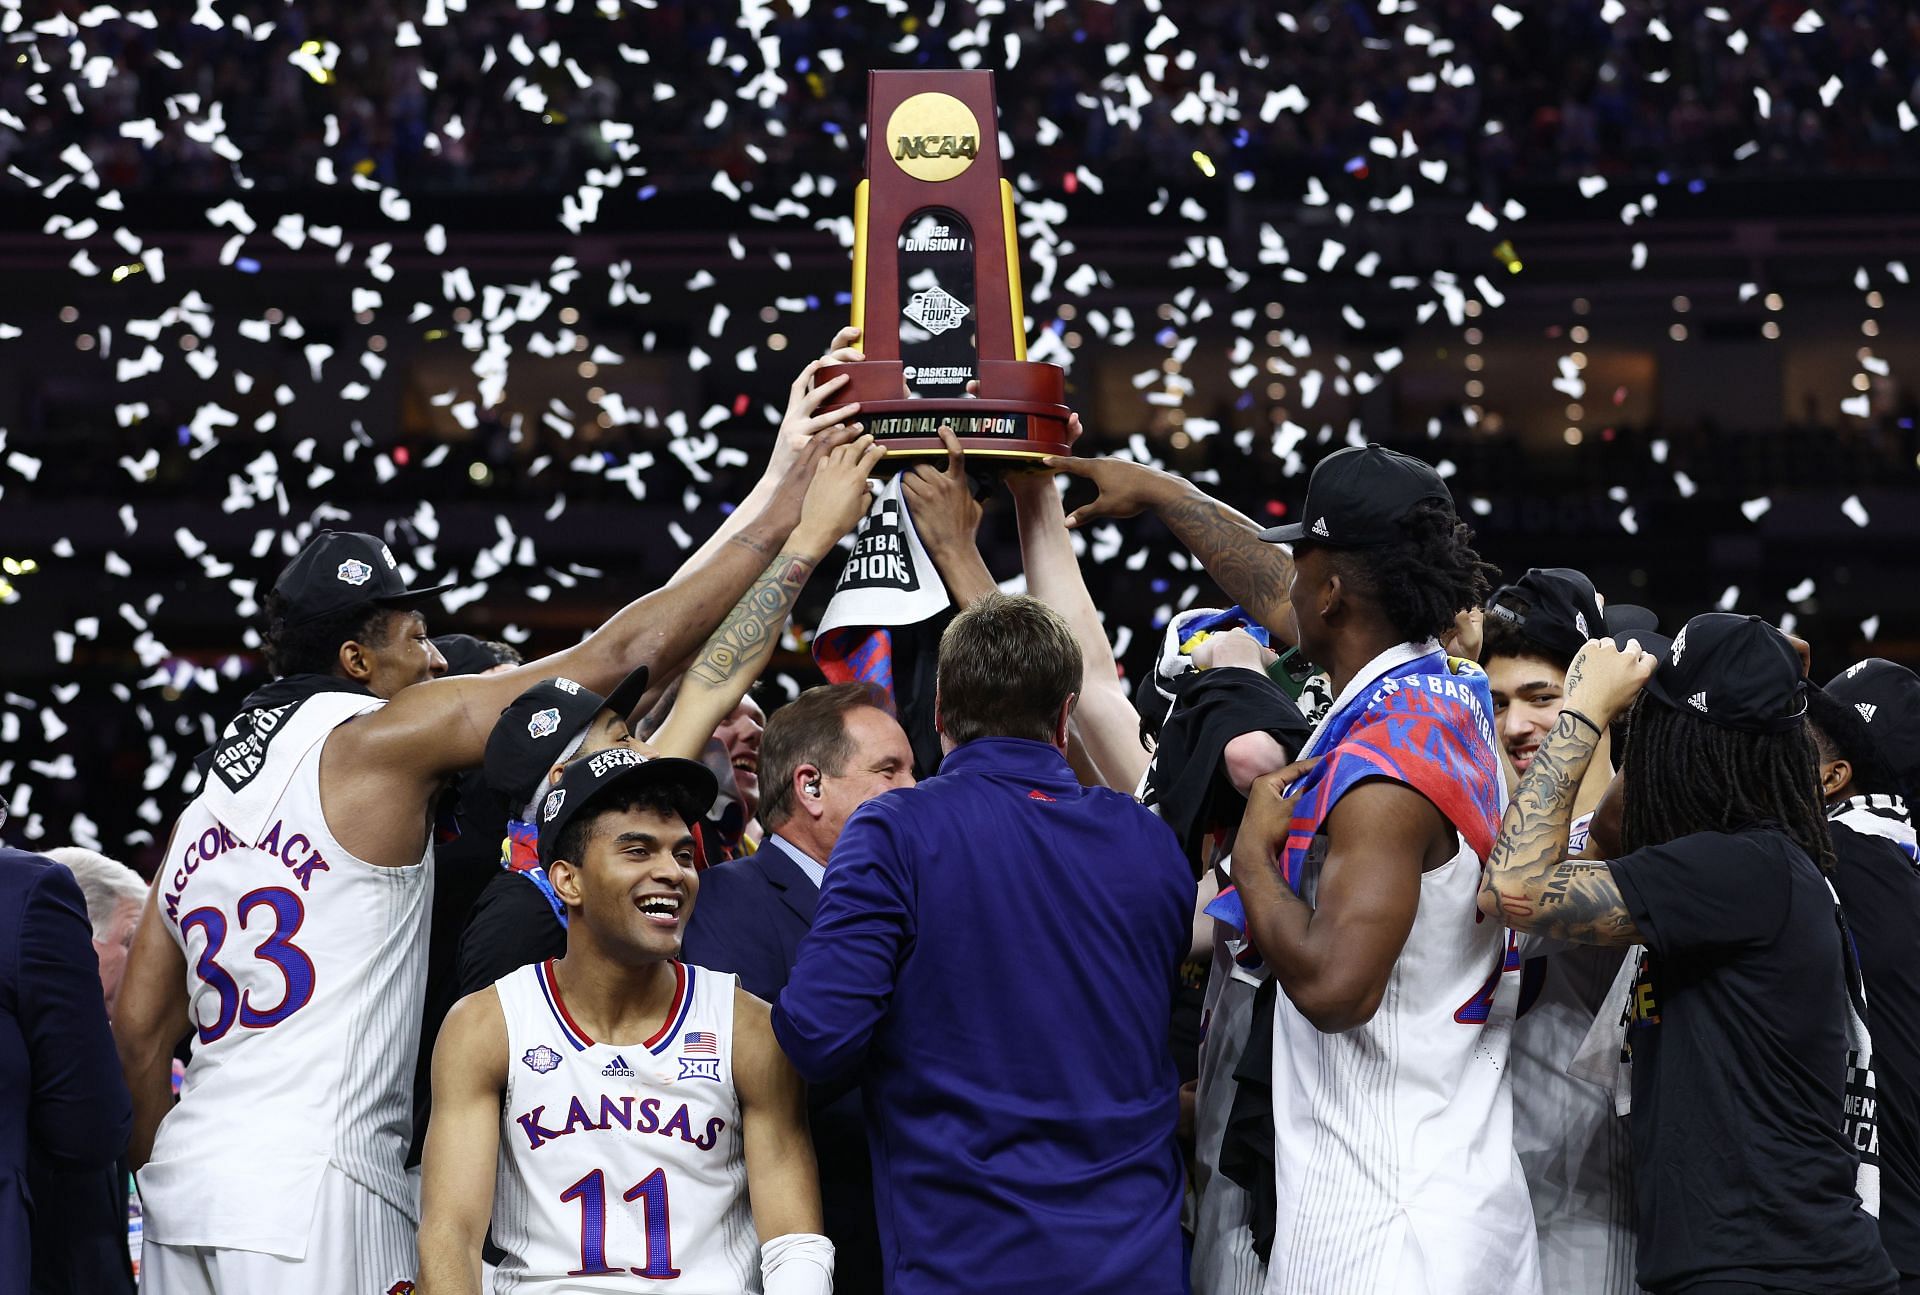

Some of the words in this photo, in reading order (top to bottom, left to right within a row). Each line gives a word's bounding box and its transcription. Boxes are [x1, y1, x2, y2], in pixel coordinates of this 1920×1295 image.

[895, 136, 978, 160] NCAA
[924, 226, 950, 238] 022
[905, 238, 959, 251] DIVISION
[923, 298, 952, 308] FINAL
[921, 309, 951, 320] FOUR
[917, 367, 972, 378] BASKETBALL
[916, 377, 963, 385] CHAMPIONSHIP
[870, 417, 937, 434] NATIONAL
[940, 417, 1015, 434] CHAMPION
[216, 734, 258, 768] 2022
[180, 886, 316, 1045] 33
[601, 1067, 635, 1077] adidas
[517, 1094, 725, 1150] KANSAS
[560, 1168, 681, 1279] 11
